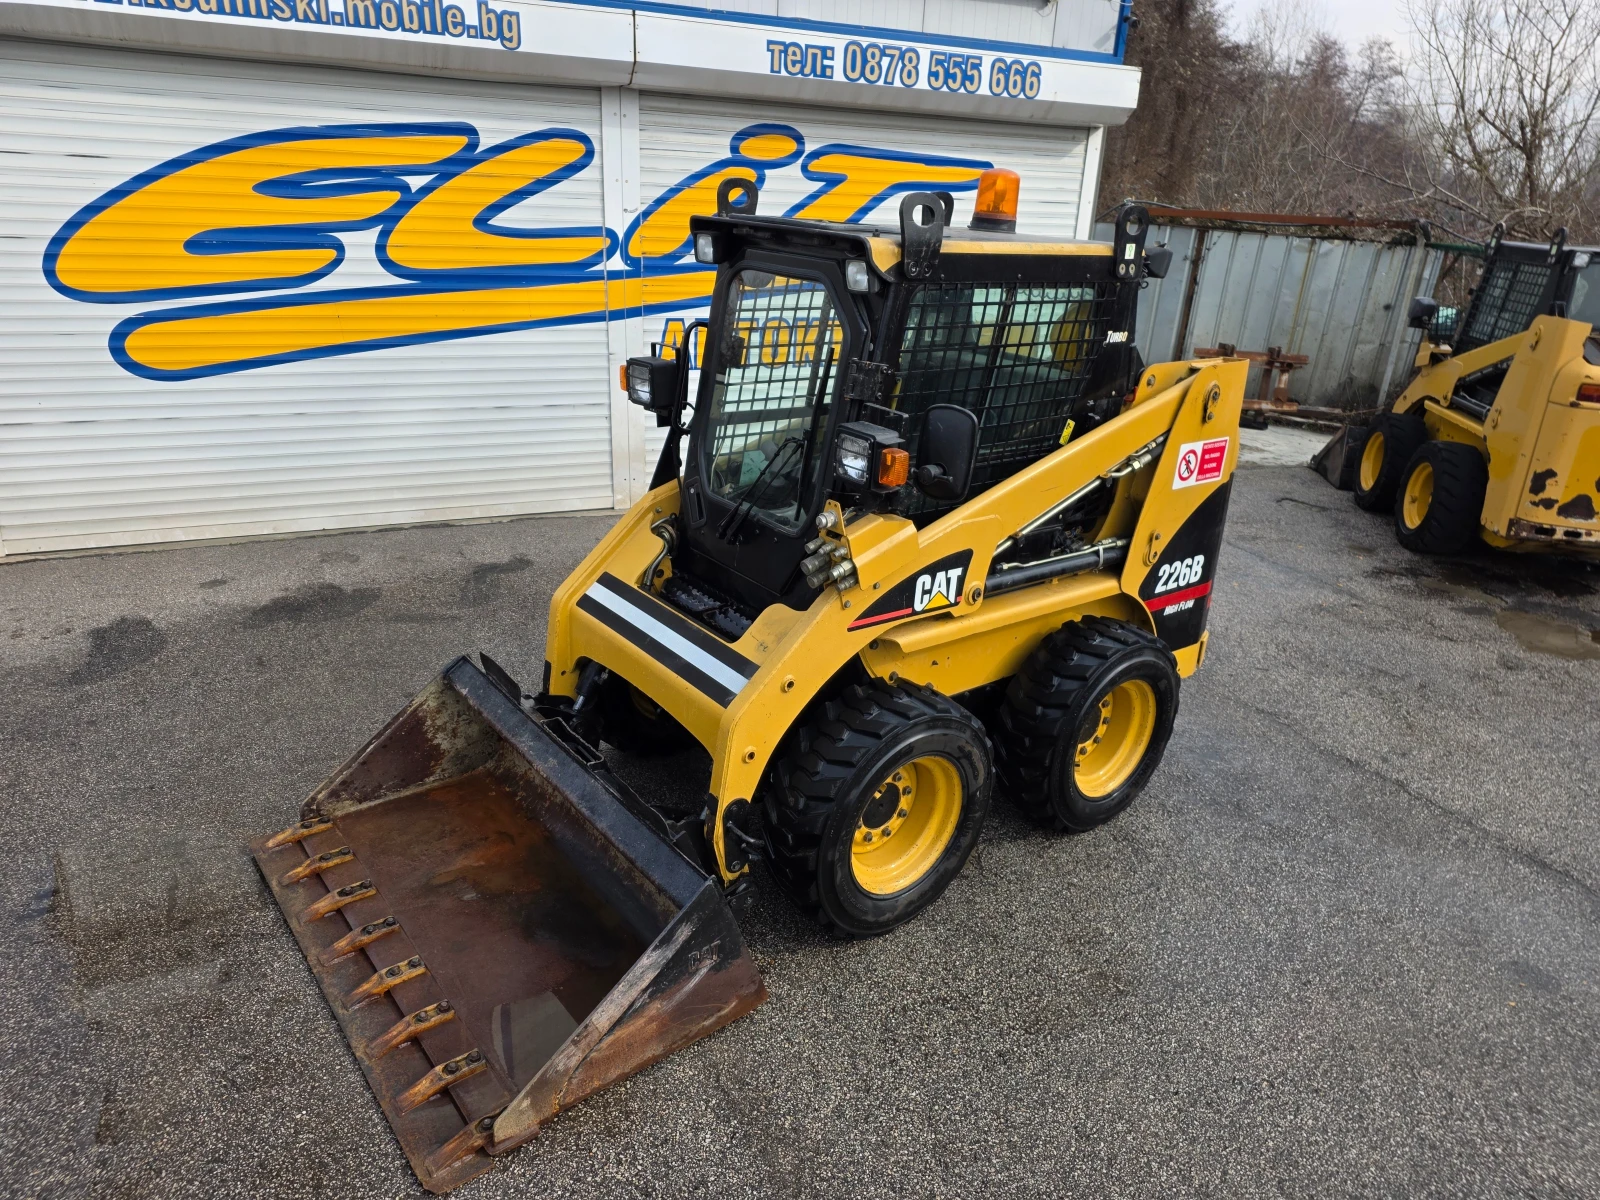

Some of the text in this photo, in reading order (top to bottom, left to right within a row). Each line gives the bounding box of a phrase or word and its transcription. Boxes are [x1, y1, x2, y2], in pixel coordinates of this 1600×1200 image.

[766, 39, 1041, 99] тел: 0878 555 666
[913, 567, 964, 612] CAT
[1154, 554, 1205, 594] 226B
